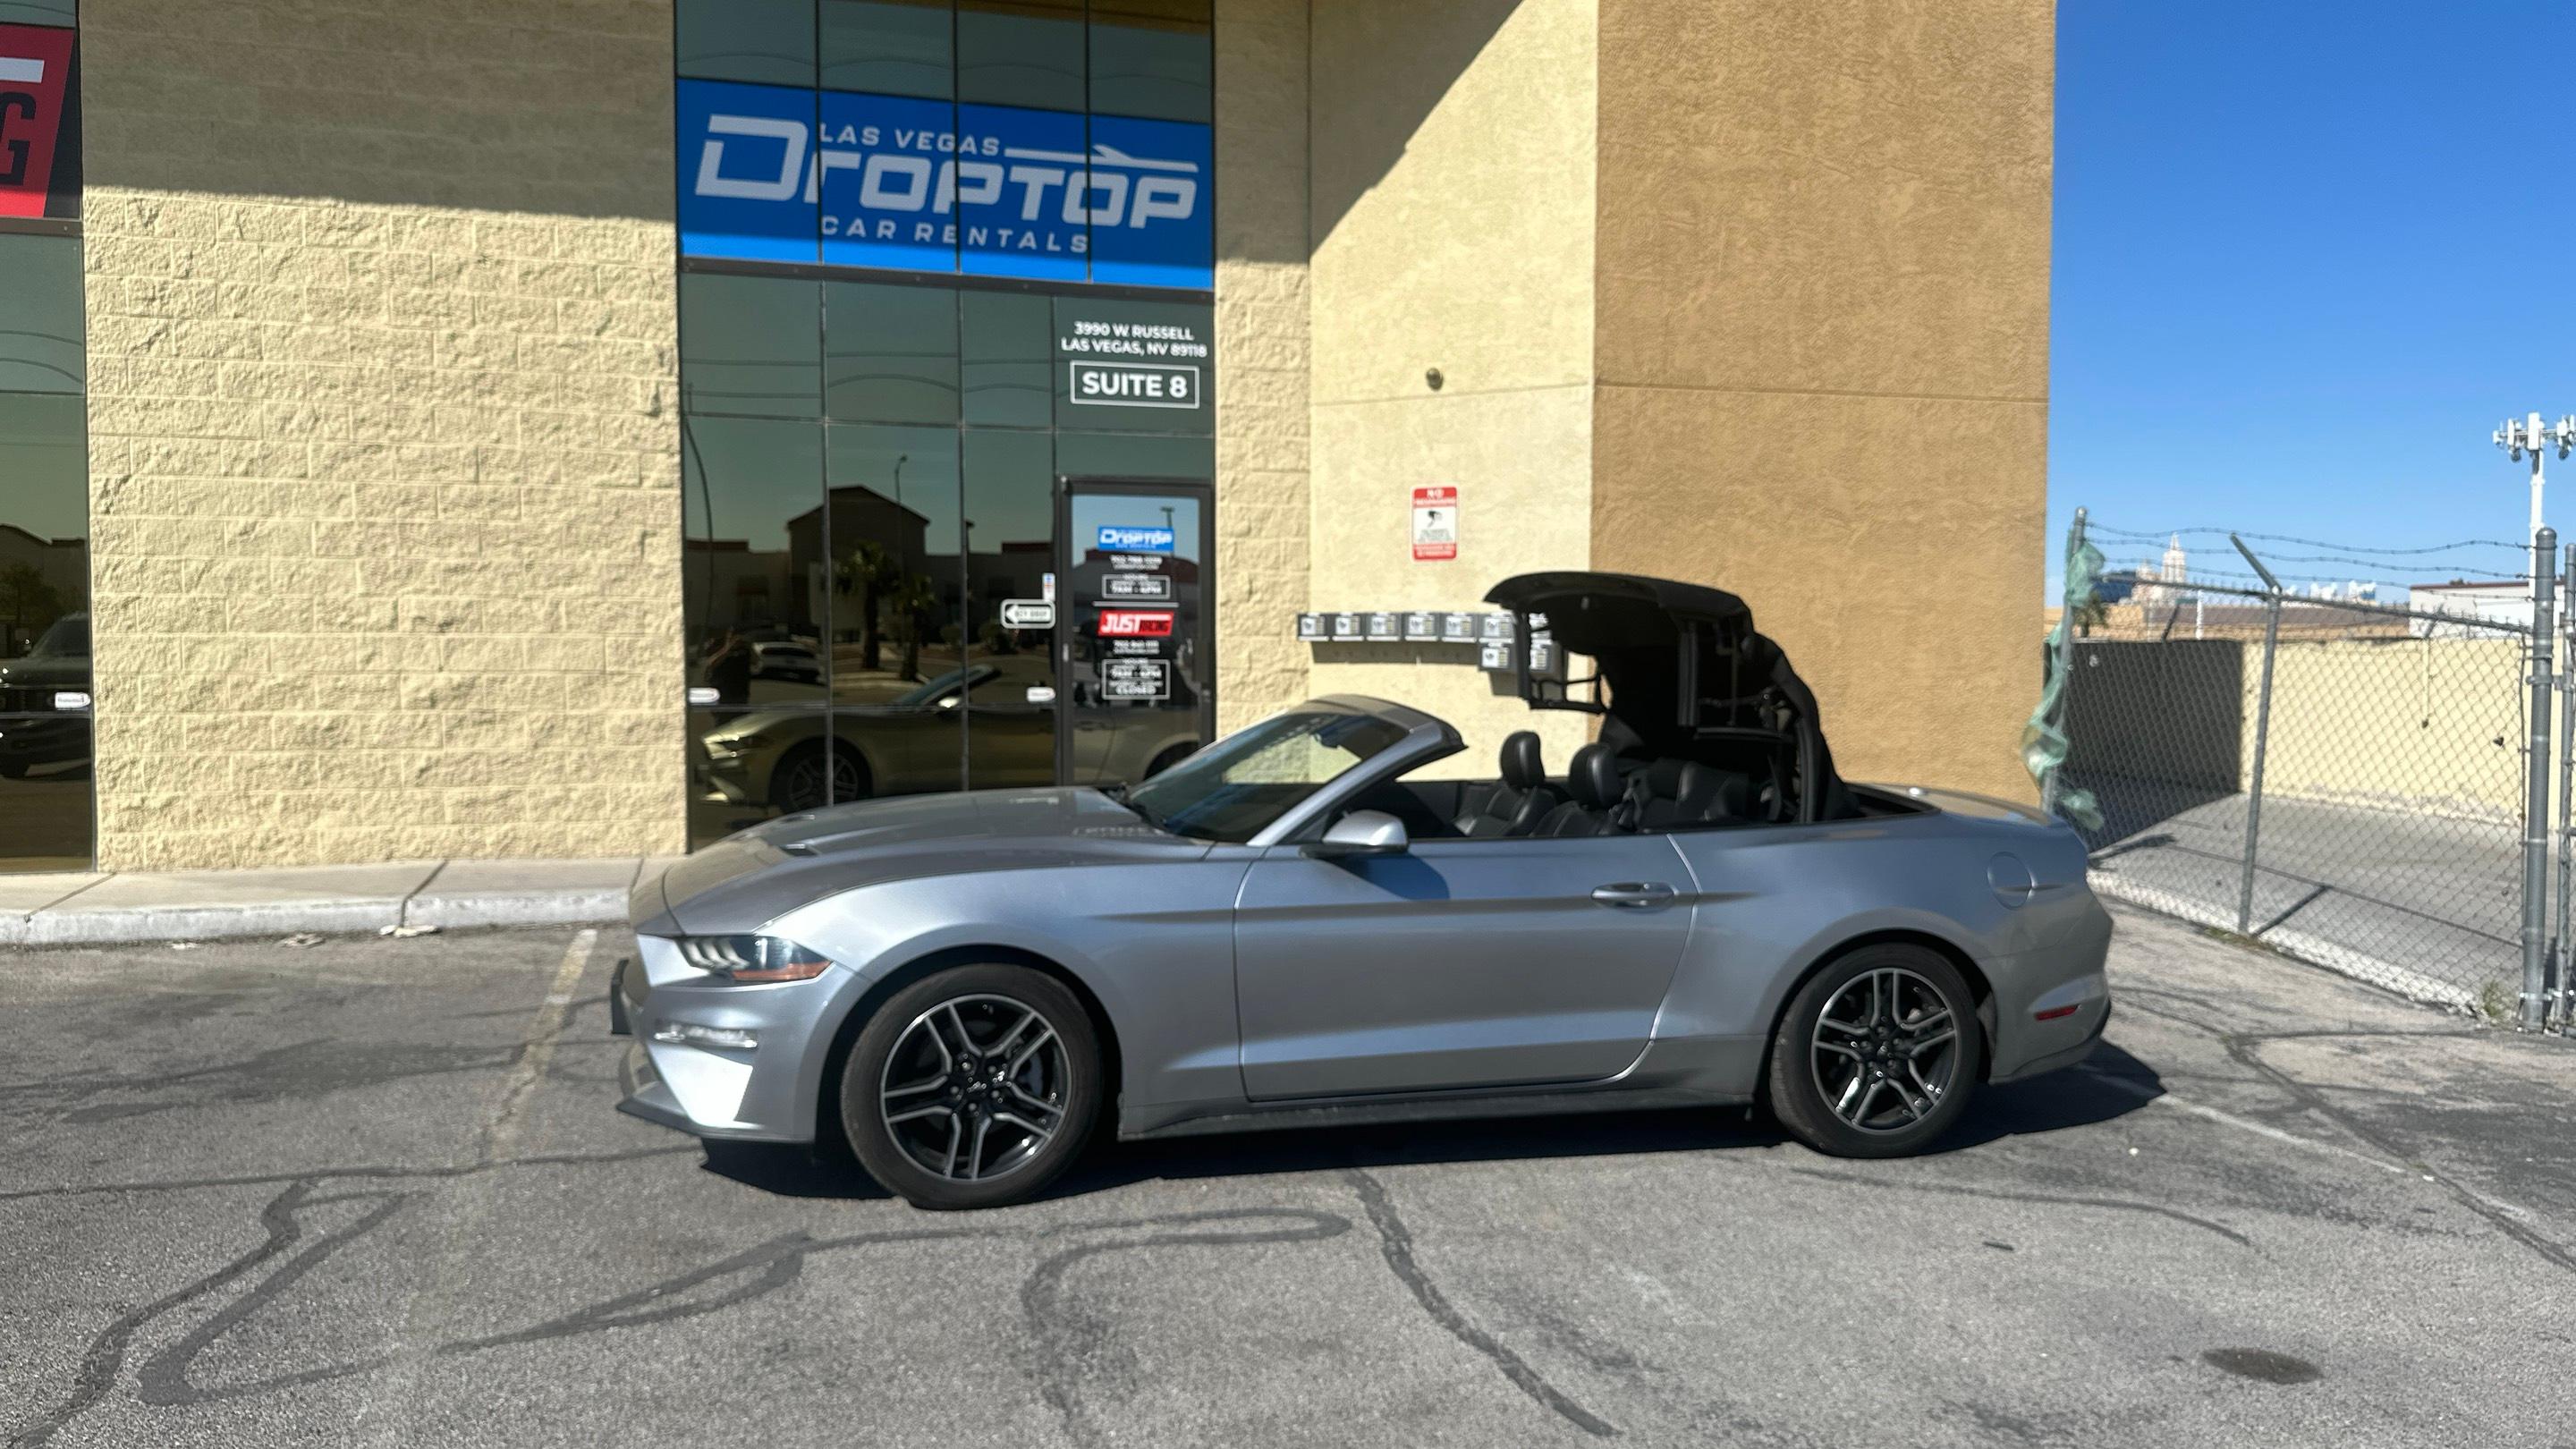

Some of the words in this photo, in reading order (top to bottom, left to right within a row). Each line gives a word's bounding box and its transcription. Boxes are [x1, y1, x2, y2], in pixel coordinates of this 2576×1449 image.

[819, 122, 881, 146] LAS
[895, 129, 1000, 156] VEGAS
[820, 216, 896, 240] CAR
[914, 222, 1089, 253] RENTALS
[1074, 321, 1111, 336] 3990
[1131, 325, 1195, 341] RUSSELL
[1061, 336, 1090, 352] LAS
[1091, 338, 1145, 356] VEGAS,
[1146, 342, 1169, 355] NV
[1169, 343, 1208, 358] 89118
[1081, 370, 1164, 397] SUITE
[1168, 375, 1188, 399] 8
[1101, 614, 1172, 633] JUST
